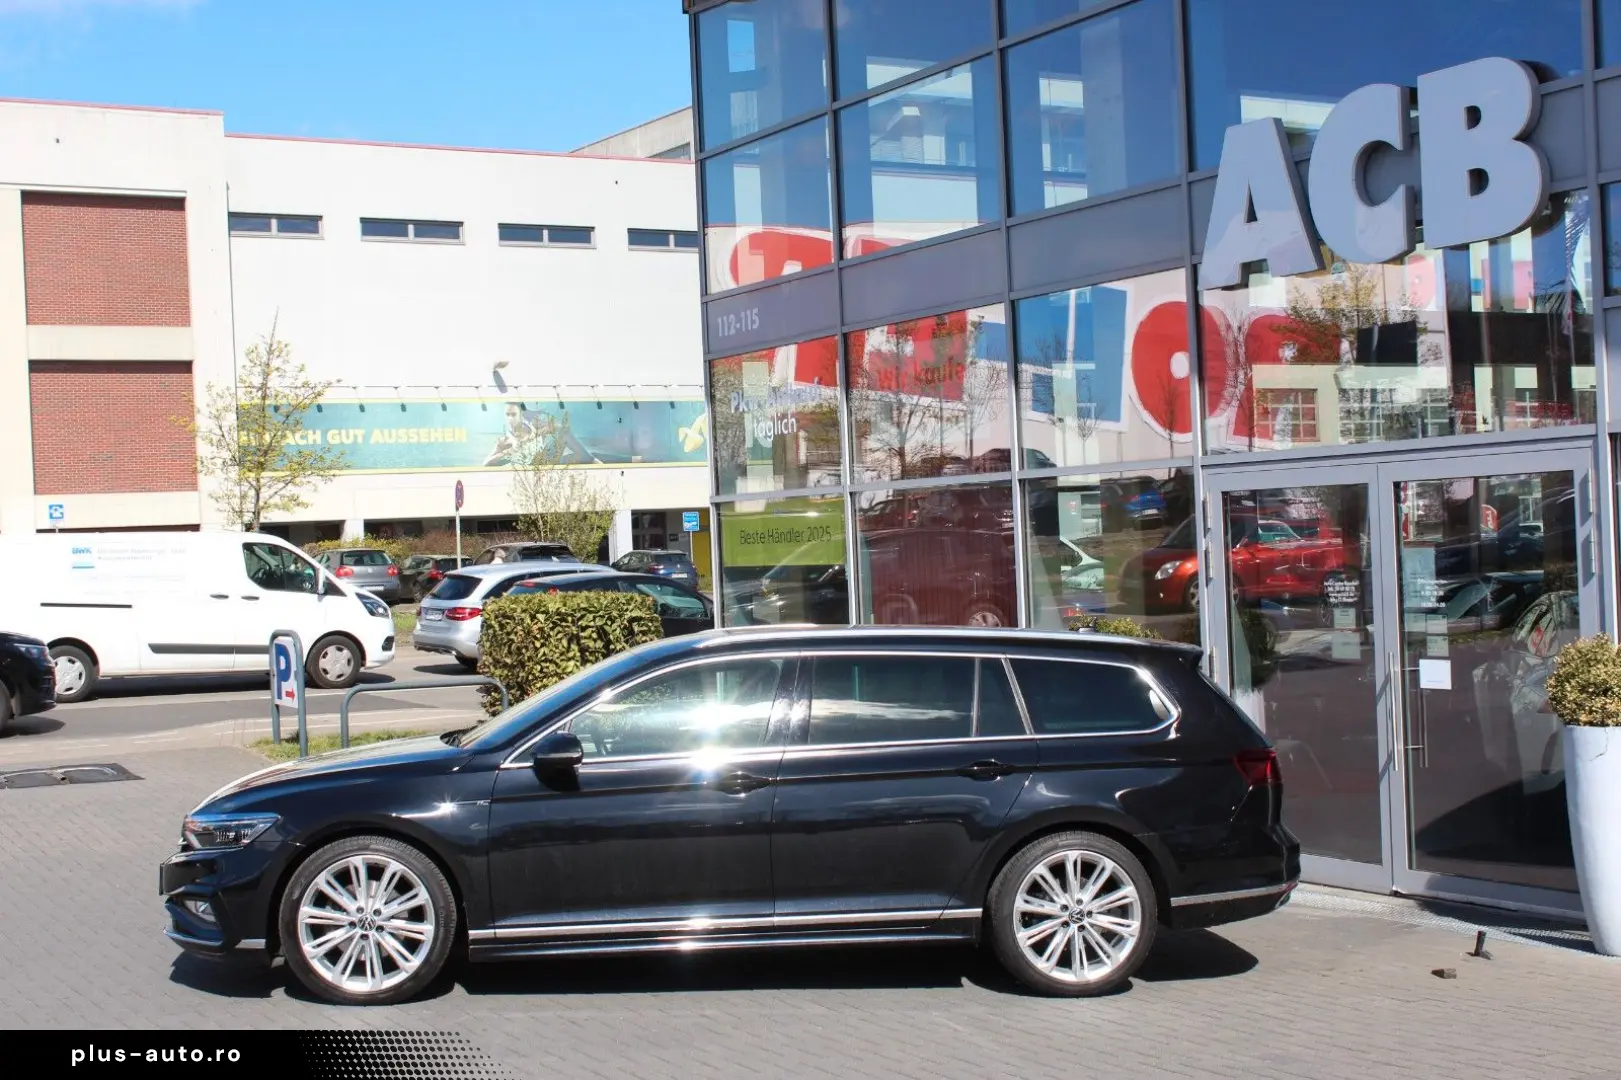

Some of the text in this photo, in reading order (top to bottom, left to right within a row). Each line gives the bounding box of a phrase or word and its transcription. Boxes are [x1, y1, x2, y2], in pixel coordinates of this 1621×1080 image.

[1200, 57, 1551, 290] ACB
[718, 307, 760, 337] 112-115
[326, 428, 365, 446] GUT
[370, 427, 468, 444] AUSSEHEN
[754, 411, 797, 442] täglich
[740, 525, 832, 545] Beste Händler 2025
[275, 642, 291, 700] P
